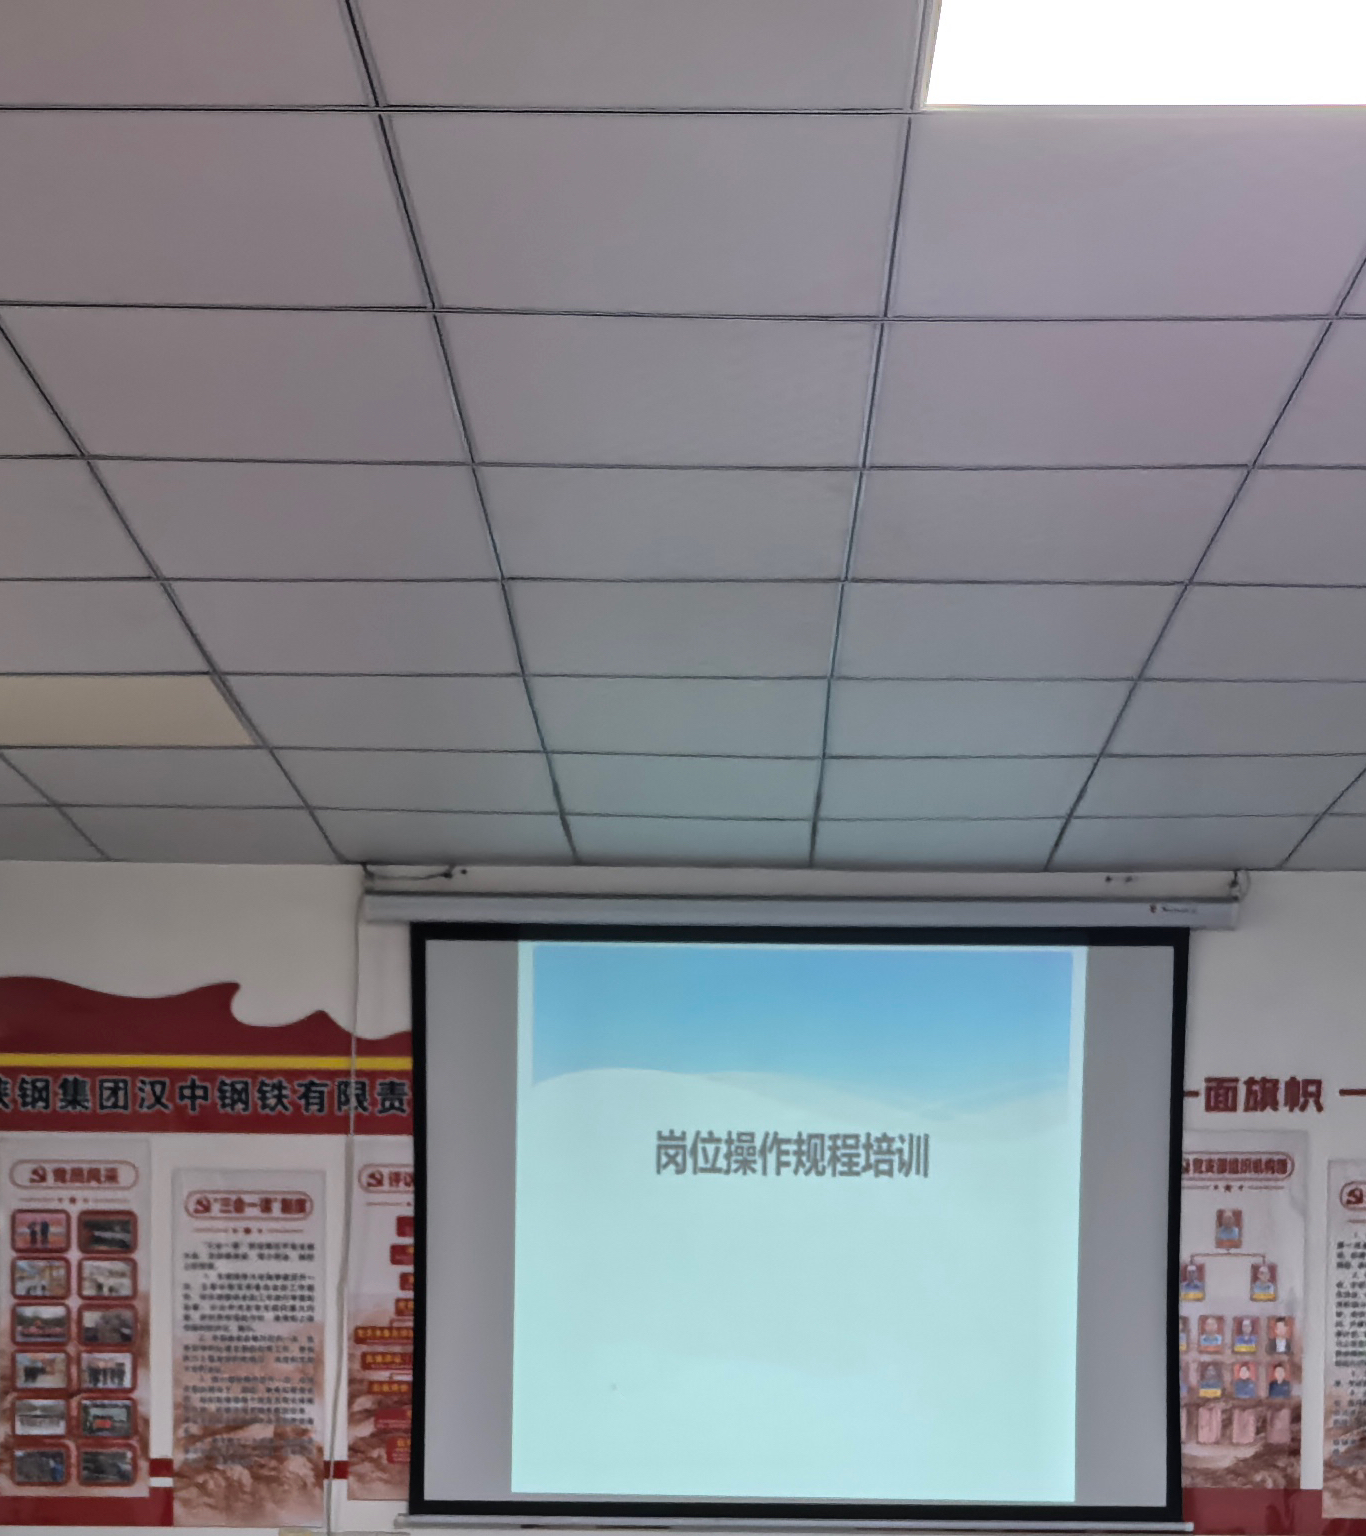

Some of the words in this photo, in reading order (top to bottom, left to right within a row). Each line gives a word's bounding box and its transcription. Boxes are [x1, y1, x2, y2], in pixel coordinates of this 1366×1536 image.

[655, 1129, 930, 1179] 岗位操作规程培训
